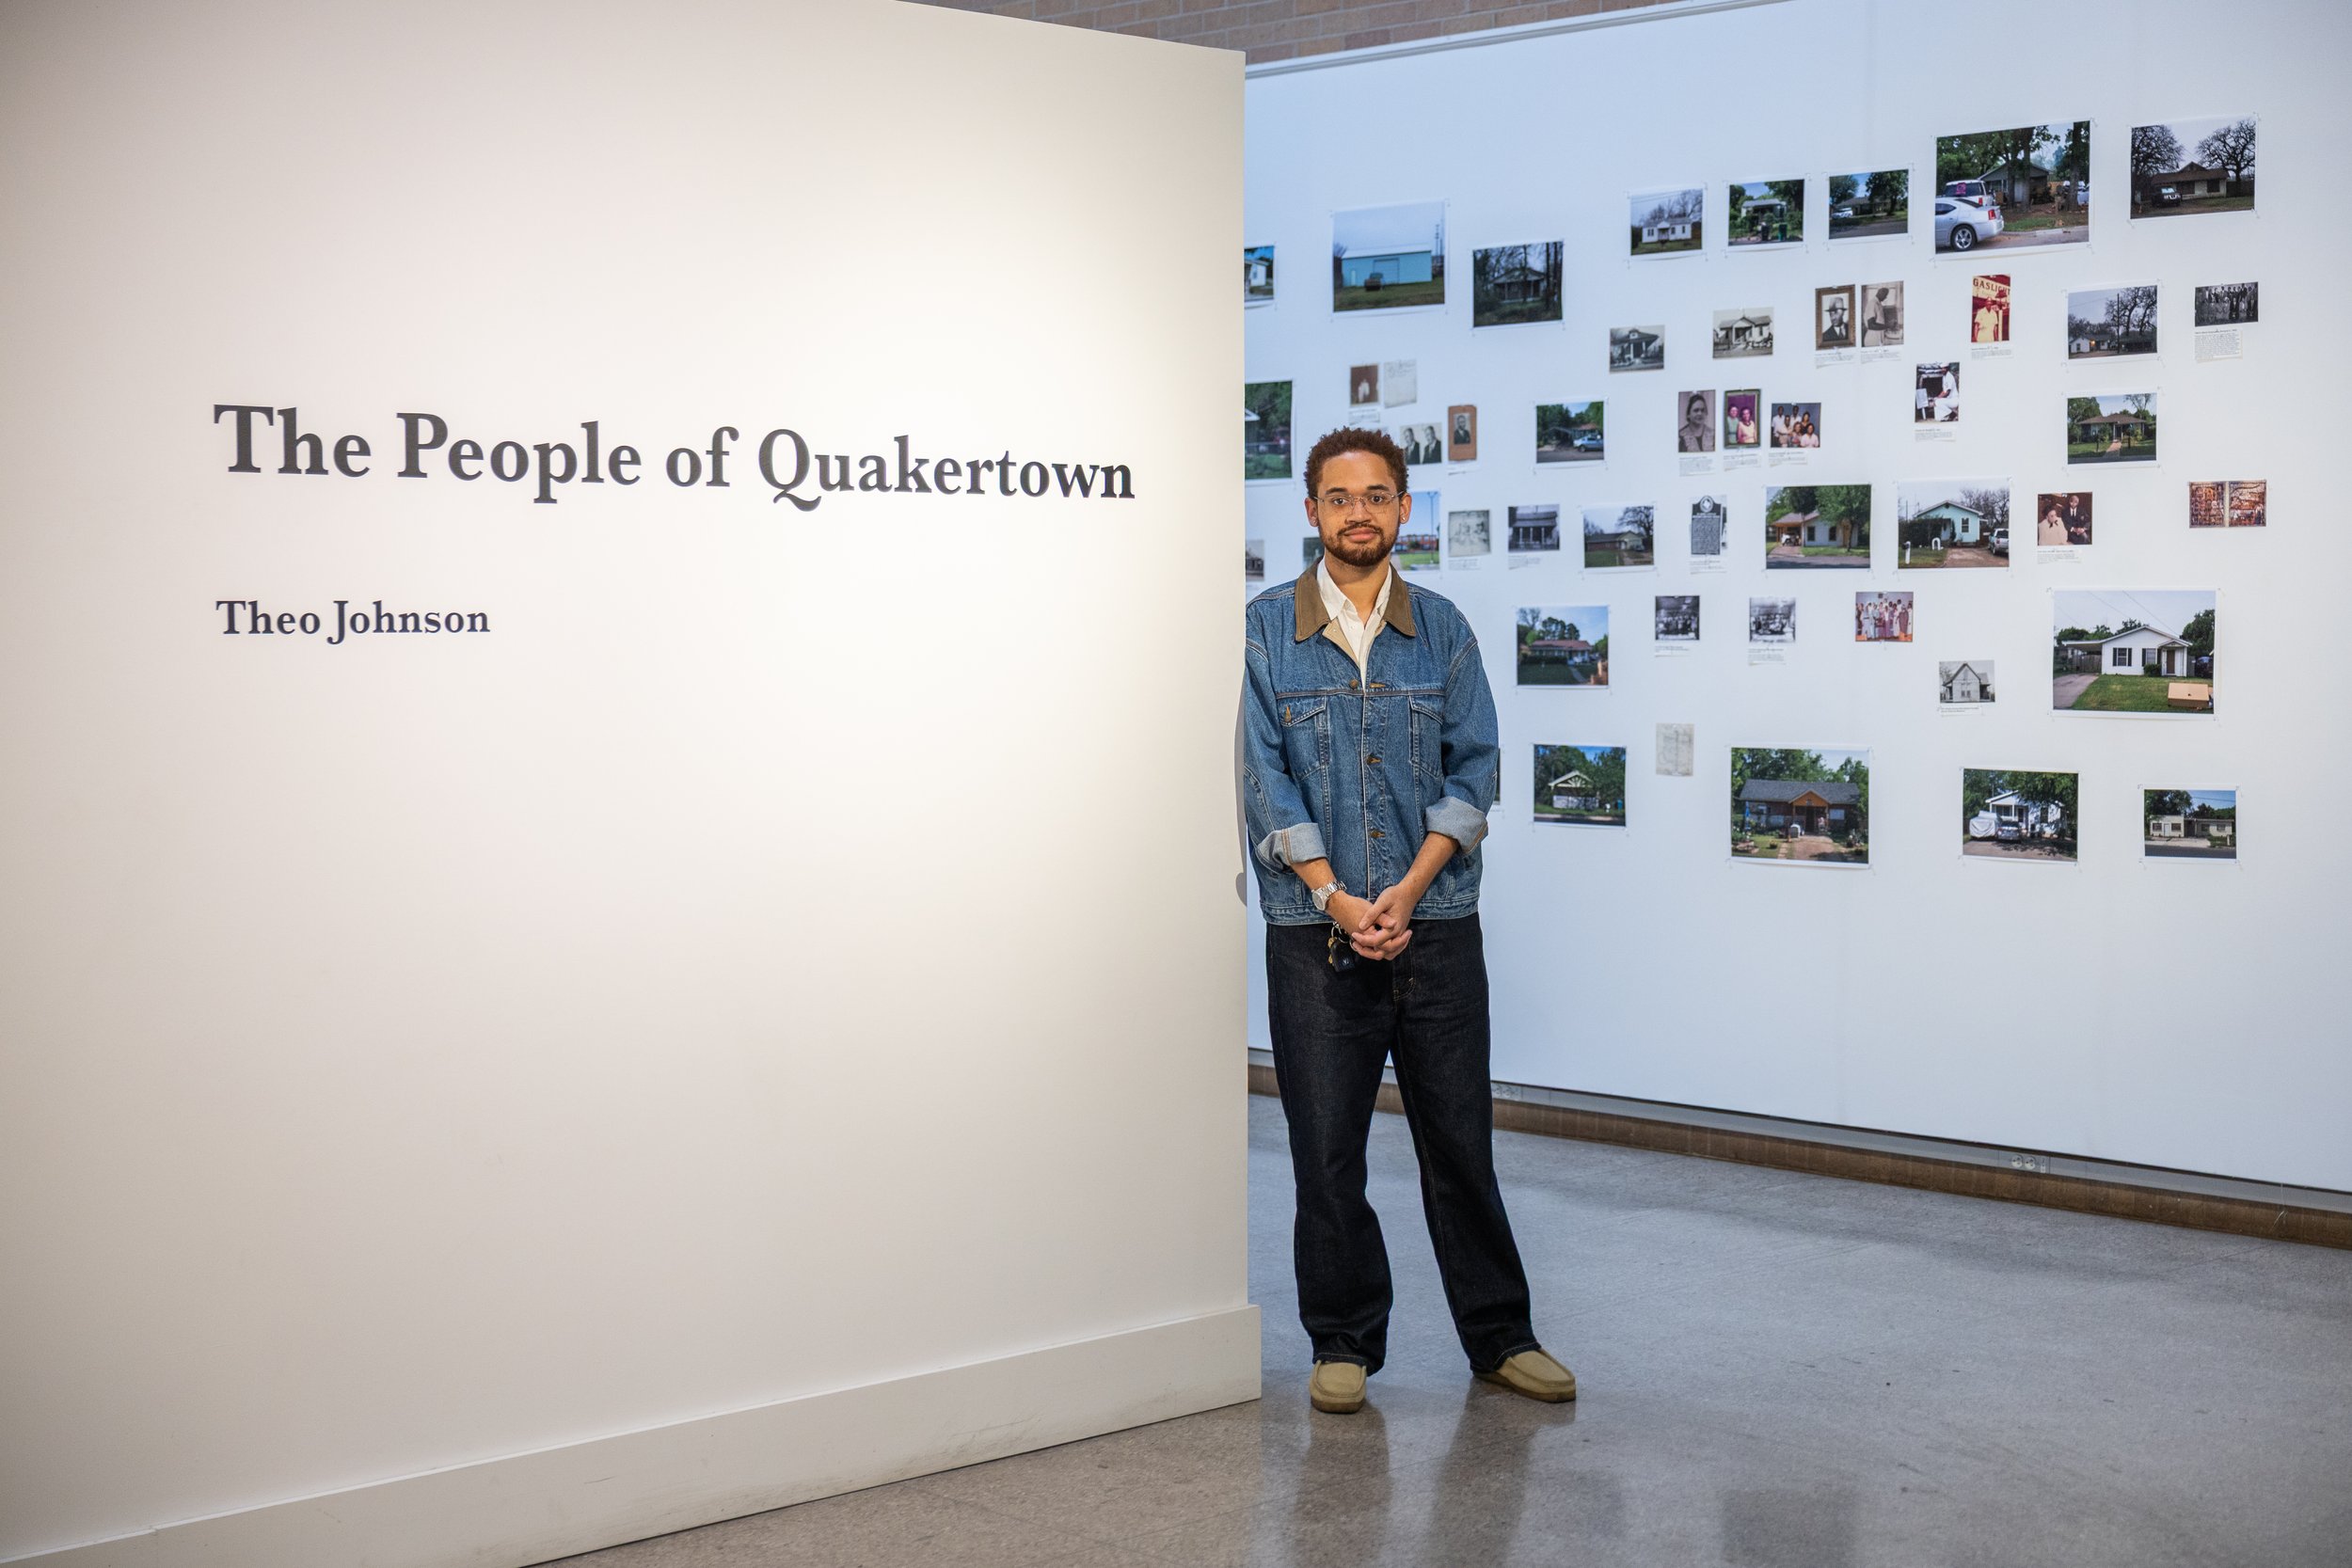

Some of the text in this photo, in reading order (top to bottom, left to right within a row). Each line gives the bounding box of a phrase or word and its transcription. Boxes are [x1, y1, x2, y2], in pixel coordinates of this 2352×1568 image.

[214, 404, 1136, 512] The People of Quakertown
[216, 600, 490, 645] Theo Johnson
